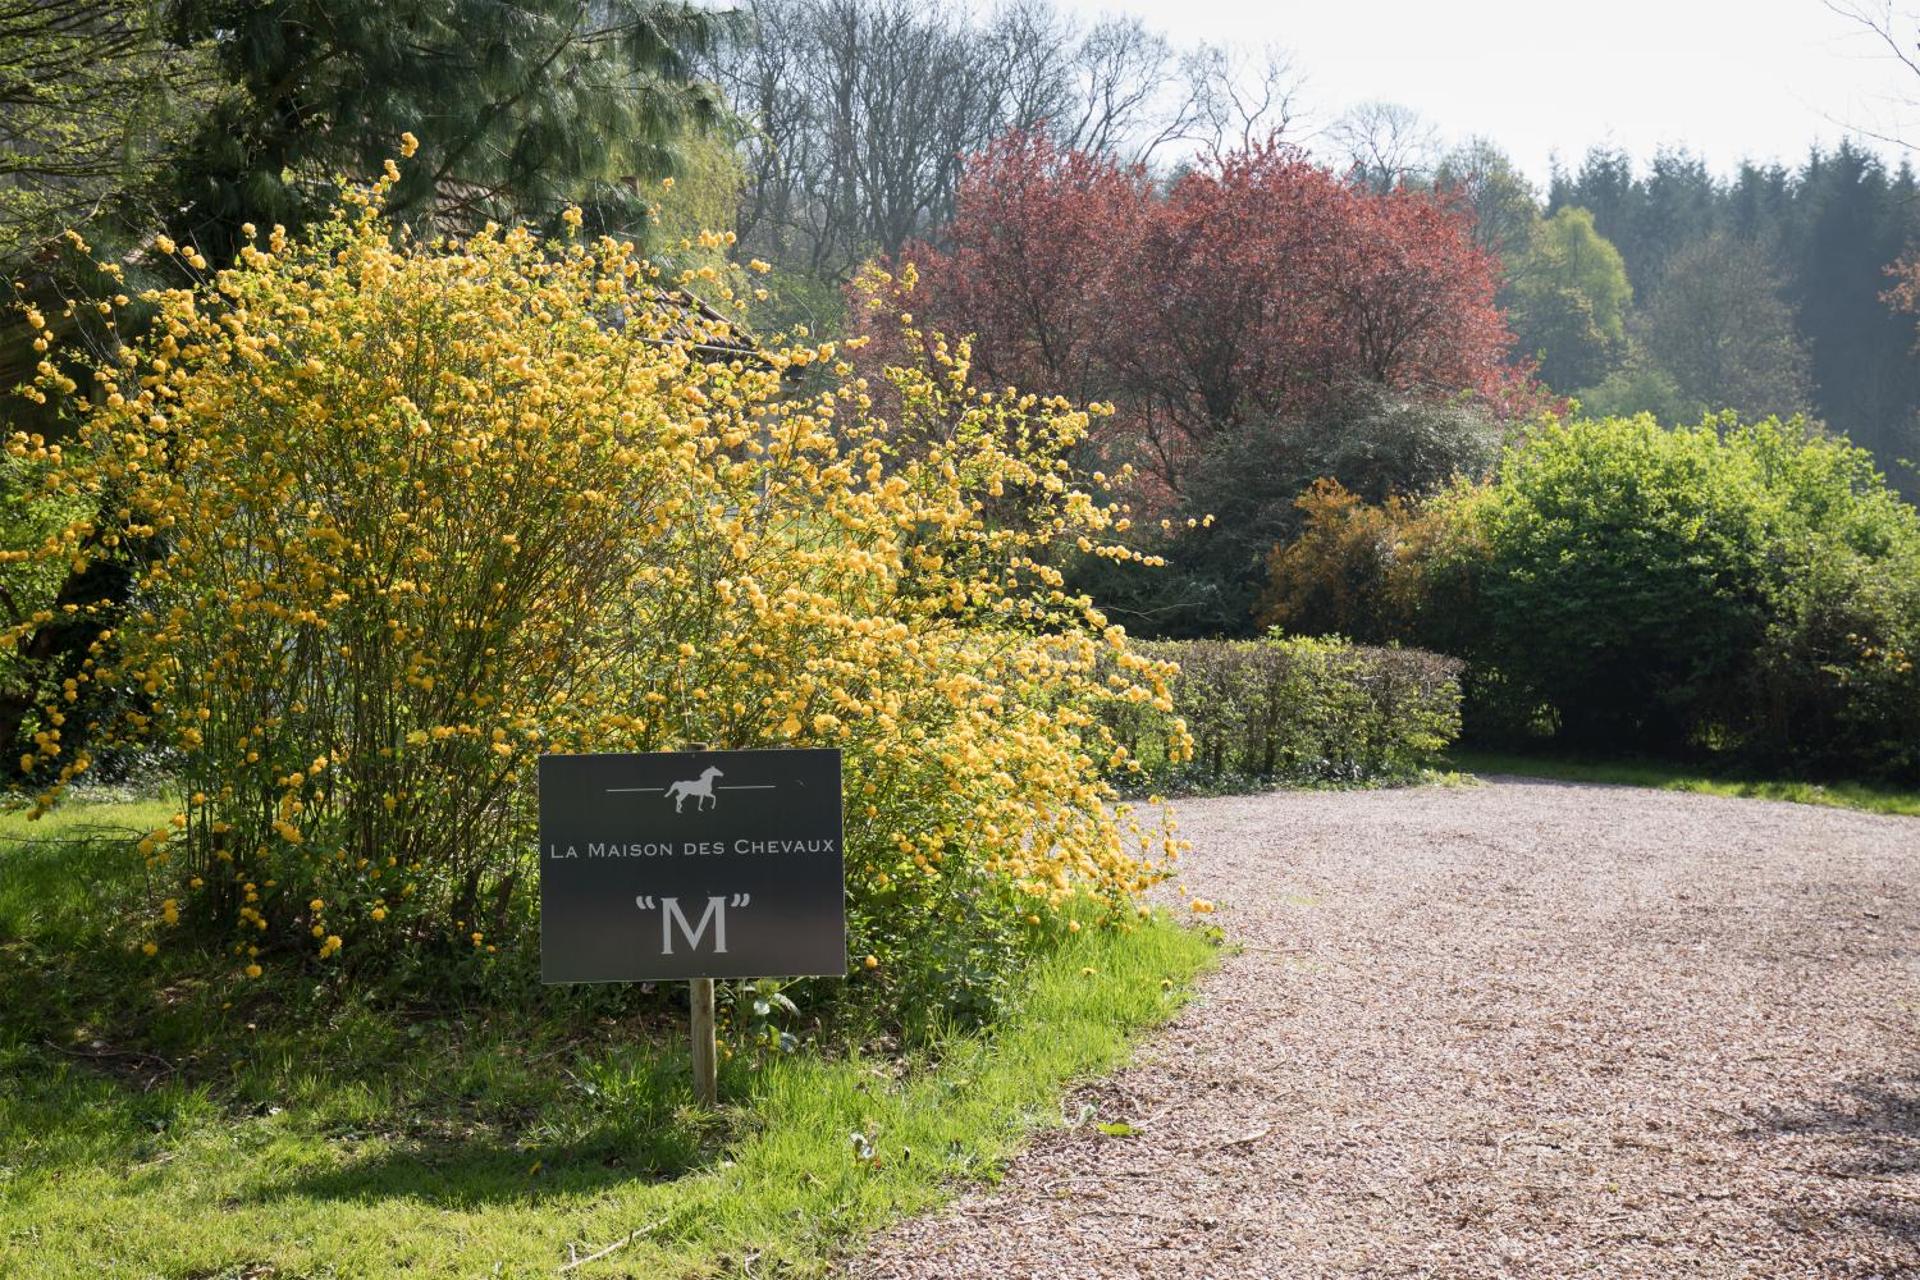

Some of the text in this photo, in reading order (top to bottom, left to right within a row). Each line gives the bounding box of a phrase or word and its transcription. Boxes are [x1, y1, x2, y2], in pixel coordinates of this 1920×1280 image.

[551, 839, 835, 859] LA MAISON DES CHEVAUX
